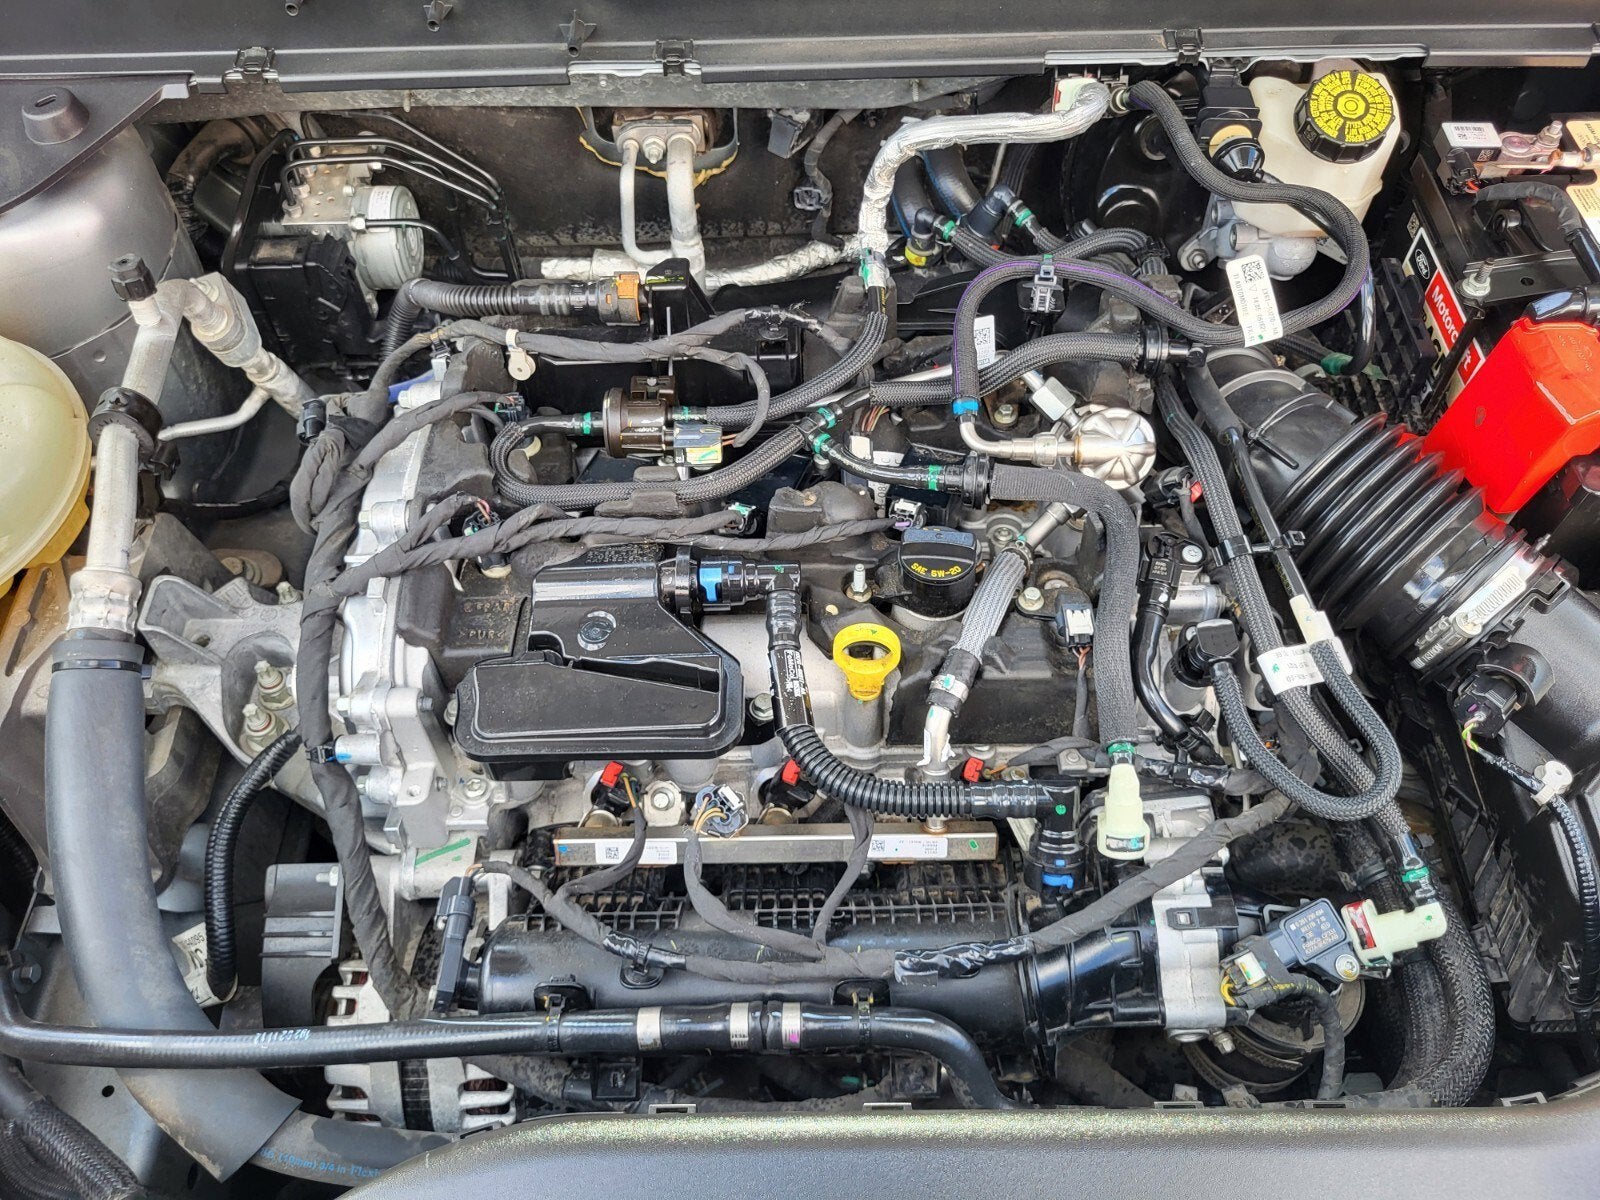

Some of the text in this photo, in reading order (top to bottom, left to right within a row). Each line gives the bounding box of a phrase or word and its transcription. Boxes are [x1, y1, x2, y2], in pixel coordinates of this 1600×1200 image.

[1431, 285, 1471, 371] Motorcft
[911, 563, 962, 578] SAE 5W-20
